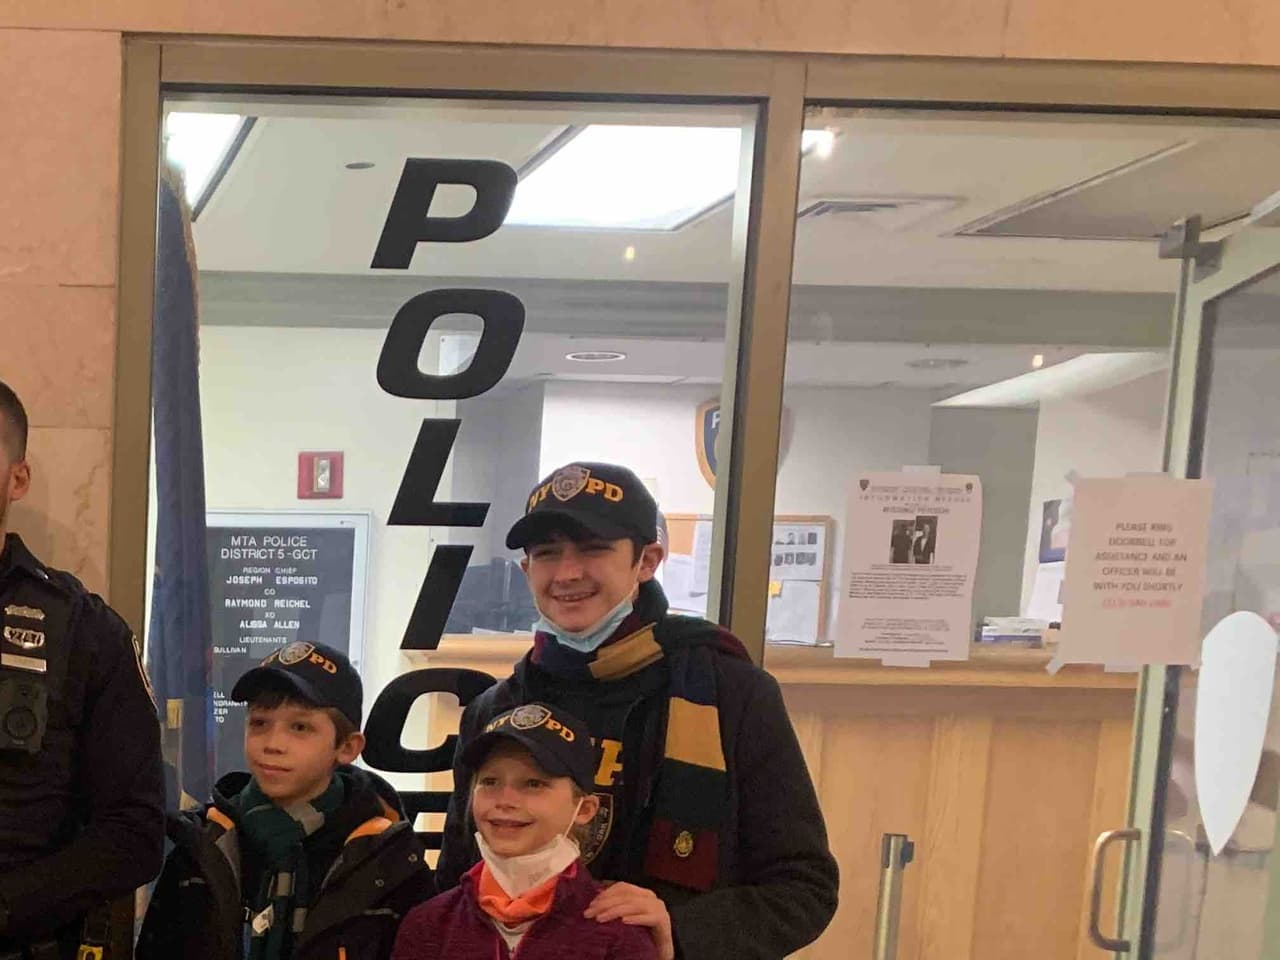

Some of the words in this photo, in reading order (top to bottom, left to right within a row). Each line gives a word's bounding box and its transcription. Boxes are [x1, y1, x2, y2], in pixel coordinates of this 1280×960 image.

[231, 535, 257, 547] MTA
[263, 535, 308, 547] POLICE
[220, 548, 275, 559] DISTRICT
[226, 576, 263, 584] JOSEPH
[275, 576, 318, 585] ESPOSITO
[1093, 582, 1118, 591] WITH
[1121, 582, 1141, 591] YOU
[225, 599, 267, 608] RAYMOND
[274, 599, 311, 608] REICHEL
[274, 620, 300, 629] ALLEN
[239, 636, 287, 644] LIEUTENANTS
